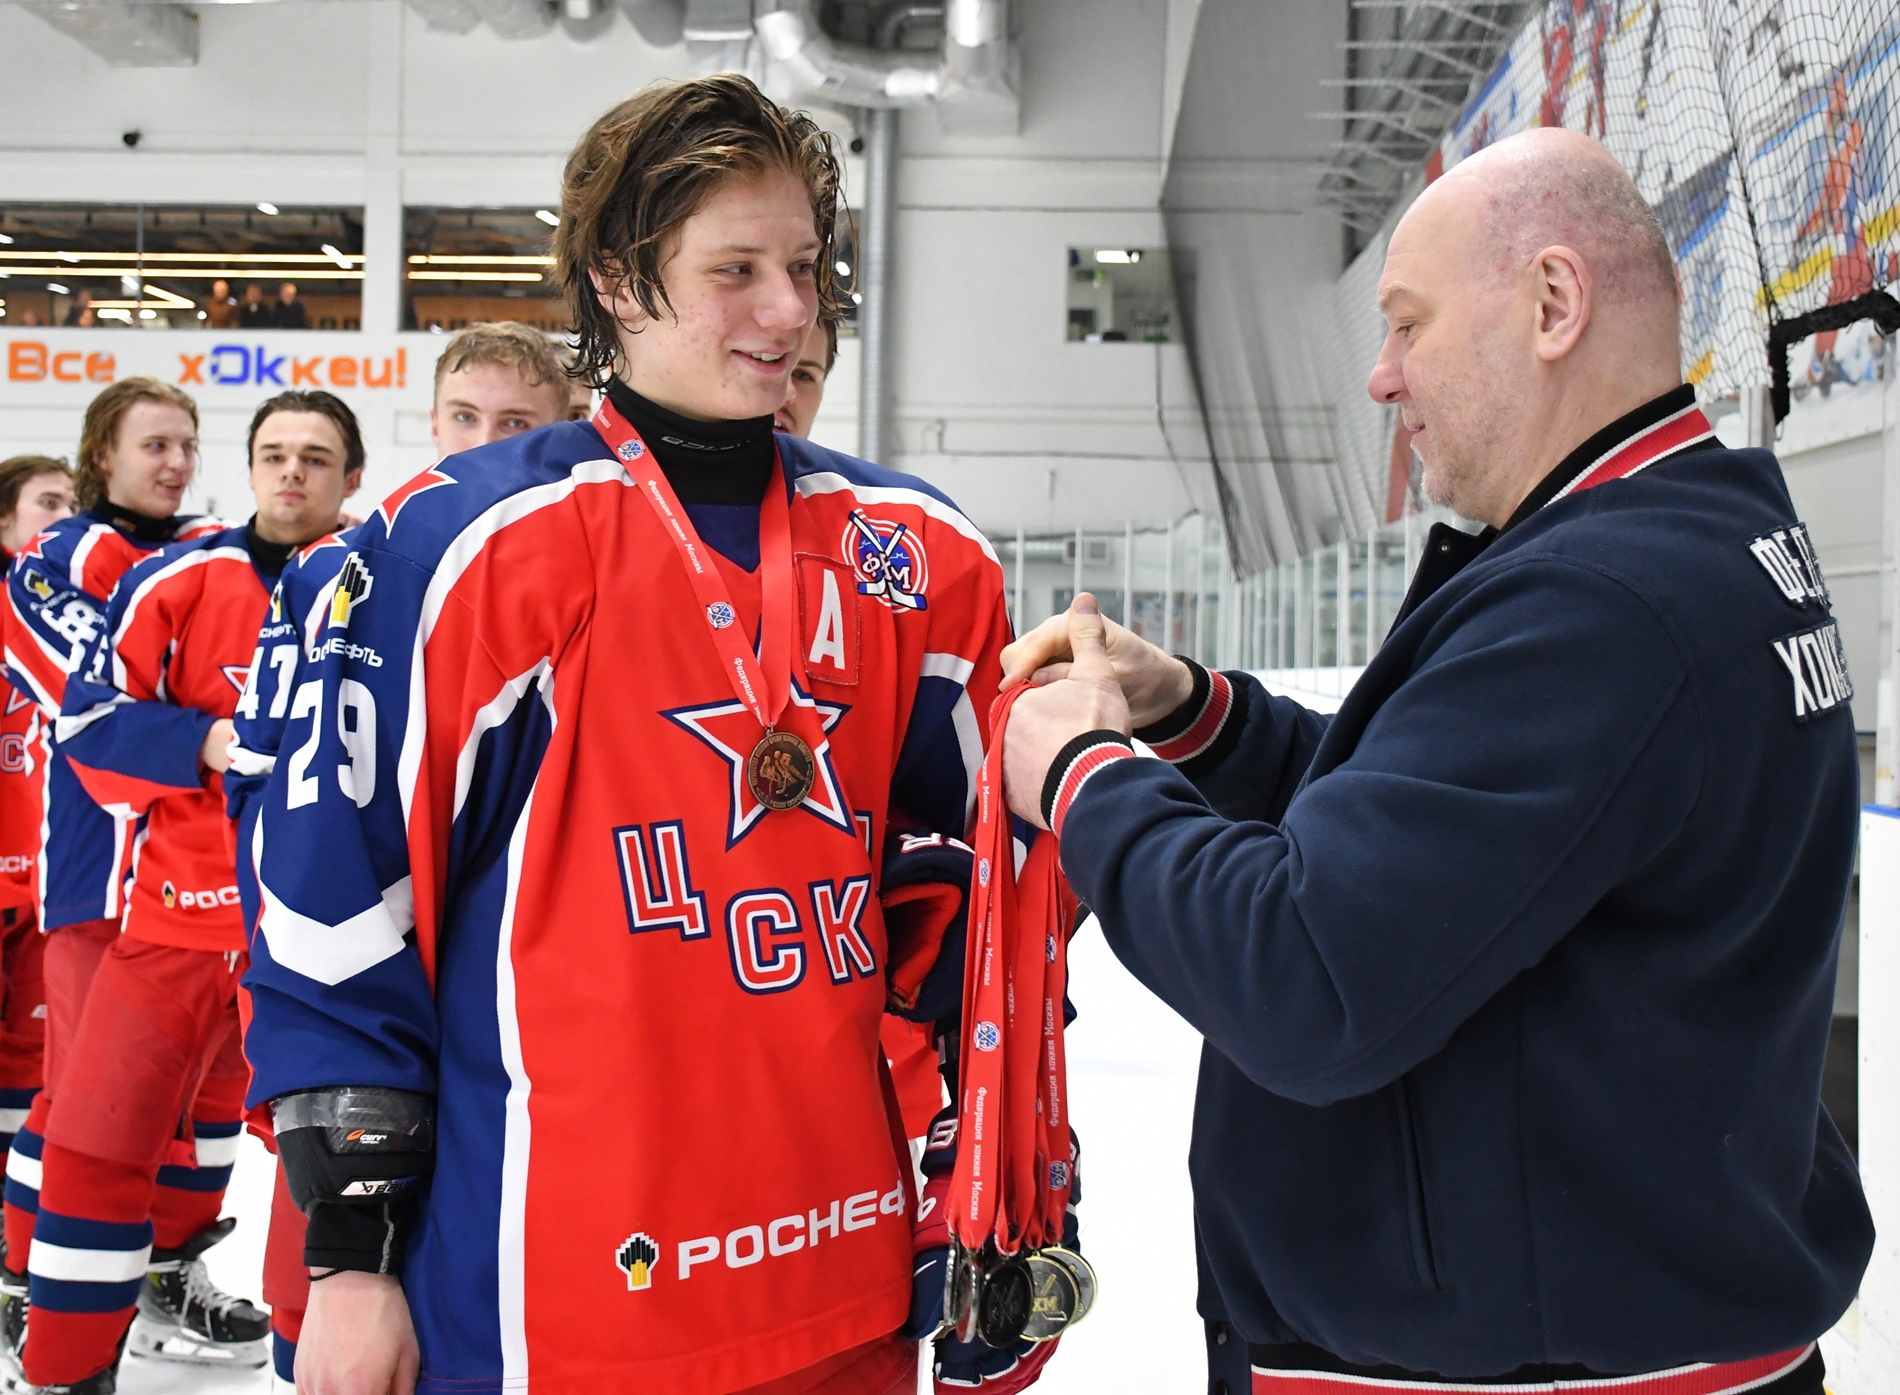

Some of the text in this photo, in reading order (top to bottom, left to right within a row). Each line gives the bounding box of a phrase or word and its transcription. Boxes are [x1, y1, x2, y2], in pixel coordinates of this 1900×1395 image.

[8, 341, 116, 383] Все
[685, 543, 704, 575] Москвы
[235, 644, 299, 720] 47
[287, 677, 377, 811] 29
[180, 885, 242, 910] РОС
[983, 947, 994, 986] Москвы
[1044, 998, 1055, 1036] Москвы
[970, 1086, 988, 1221] Федерация хоккея Москвы
[678, 1179, 906, 1281] РОСНЕФ
